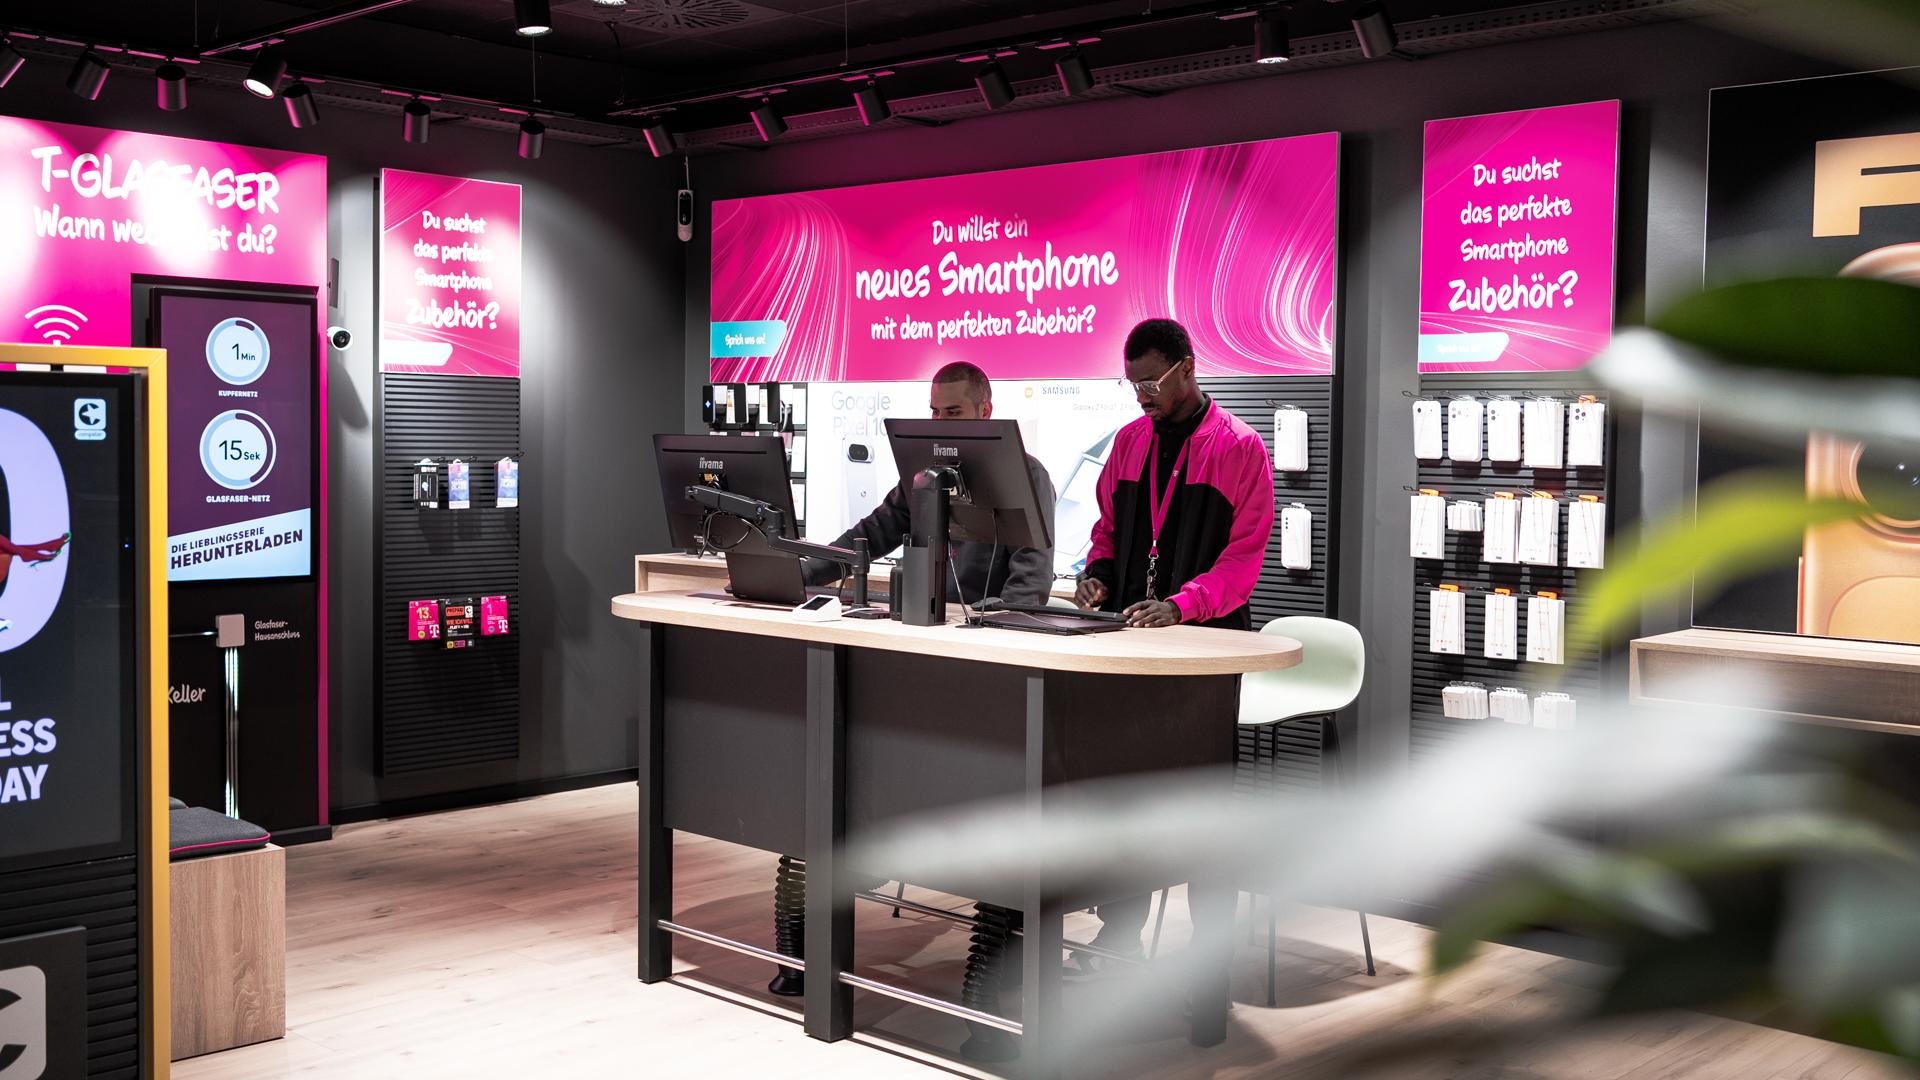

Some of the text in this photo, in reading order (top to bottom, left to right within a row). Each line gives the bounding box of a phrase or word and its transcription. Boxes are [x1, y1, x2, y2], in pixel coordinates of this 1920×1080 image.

[1473, 155, 1562, 187] Du suchst
[422, 210, 487, 234] Du suchst
[1460, 193, 1573, 228] das perfekte
[32, 203, 105, 241] Wann
[237, 222, 278, 255] du?
[931, 213, 1028, 246] Du willst ein
[413, 238, 438, 259] das
[1460, 232, 1569, 265] Smartphone
[856, 241, 1120, 303] neues Smartphone
[1448, 269, 1578, 314] Zubehör?
[406, 297, 499, 330] Zubehör?
[871, 304, 1097, 345] mit dem perfekten Zubehör?
[232, 343, 256, 361] 1 Min
[218, 390, 258, 398] KUPFERNETZ
[832, 390, 891, 416] Google
[1042, 386, 1080, 395] SAMSUNG
[218, 440, 260, 461] 15 Sek
[699, 456, 724, 470] iiyama
[933, 443, 958, 457] iiyama
[206, 495, 271, 503] GLASFASER-NETZ
[170, 529, 303, 570] HERUNTERLADEN
[171, 526, 265, 554] DIE LIEBLINGSSERIE
[254, 620, 288, 630] Glasfaser-
[254, 631, 300, 641] Hausanschluss
[0, 764, 49, 804] AY
